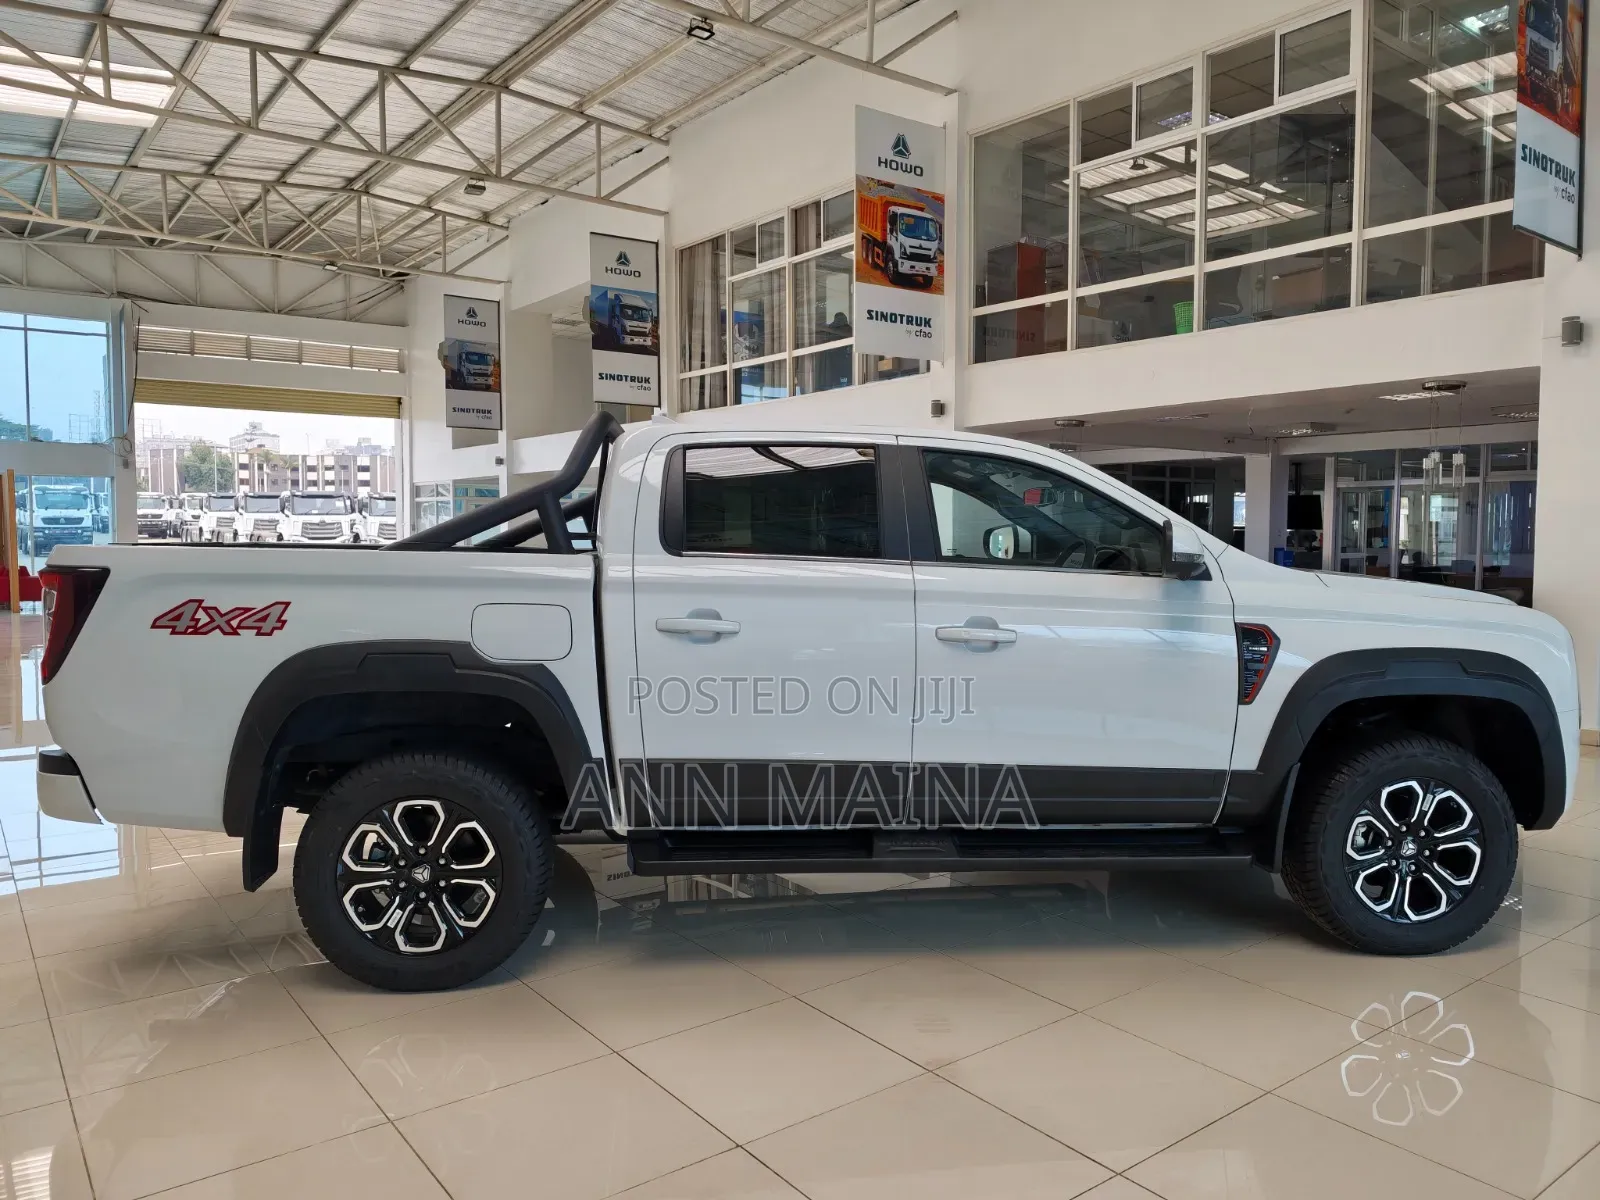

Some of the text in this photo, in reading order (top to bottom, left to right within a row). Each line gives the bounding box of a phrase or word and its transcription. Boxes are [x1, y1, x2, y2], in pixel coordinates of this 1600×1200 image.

[877, 156, 924, 177] HOWO
[1521, 143, 1575, 188] SINOTRUK
[605, 266, 641, 278] HOWO
[457, 318, 487, 328] HOWO
[866, 309, 932, 328] SINOTRUK
[914, 328, 932, 339] cfao
[598, 372, 651, 384] SINOTRUK
[452, 406, 492, 415] SINOTRUK
[150, 598, 291, 637] 4x4
